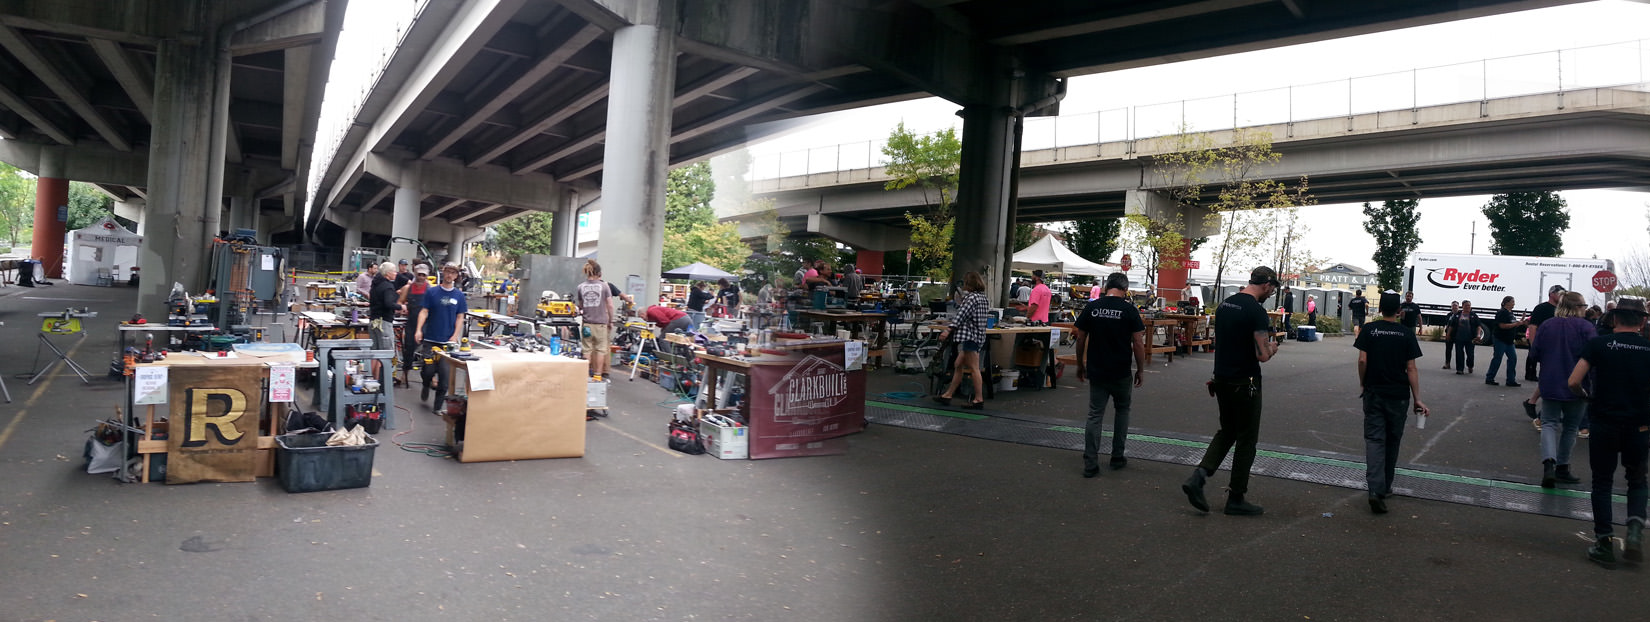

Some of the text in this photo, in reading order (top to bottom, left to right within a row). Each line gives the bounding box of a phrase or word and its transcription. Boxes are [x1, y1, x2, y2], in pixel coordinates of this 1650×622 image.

[95, 235, 126, 244] MEDICAL
[1319, 274, 1348, 283] PRATT
[1351, 275, 1359, 284] &
[1443, 267, 1500, 285] Ryder
[1593, 276, 1616, 286] STOP
[1463, 282, 1480, 291] Ever
[1099, 308, 1123, 317] LOVETT
[789, 372, 844, 403] CLARKBUILT
[181, 387, 247, 447] R
